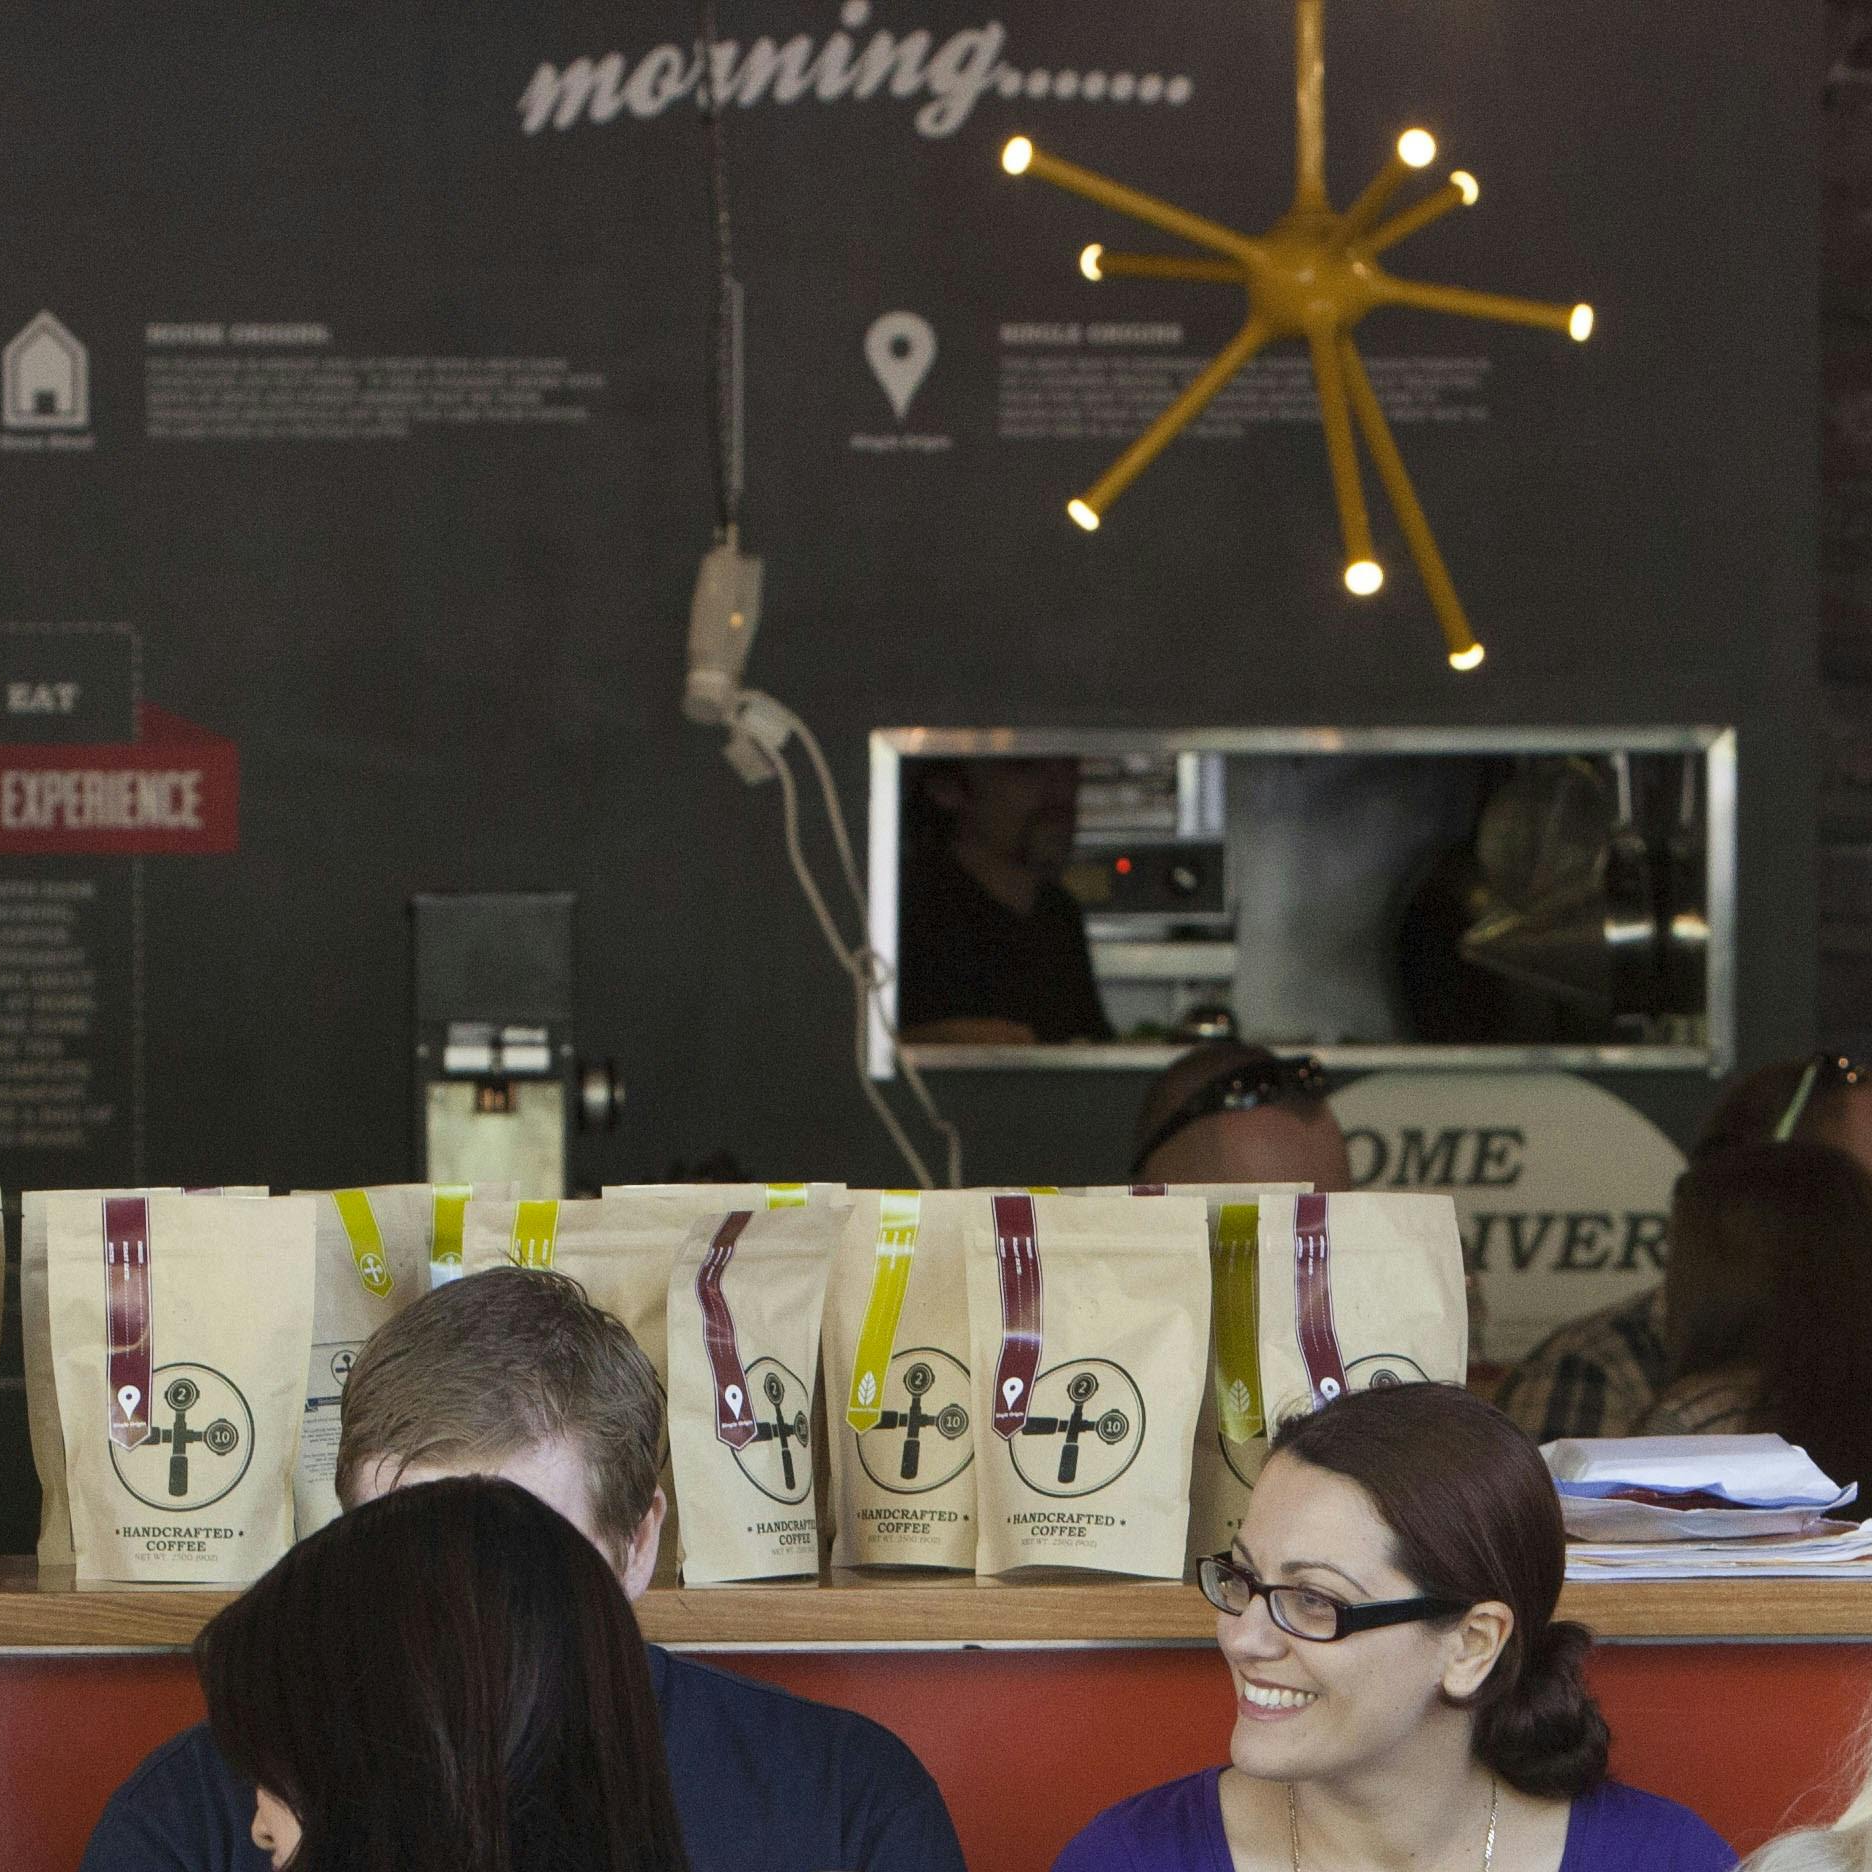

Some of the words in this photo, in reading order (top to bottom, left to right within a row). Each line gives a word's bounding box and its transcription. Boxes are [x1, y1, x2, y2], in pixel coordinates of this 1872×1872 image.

[6, 682, 81, 713] EAT
[0, 769, 203, 830] EXPERIENCE
[1345, 1126, 1526, 1187] OME
[1465, 1209, 1667, 1272] IVER
[914, 1372, 923, 1386] 2
[177, 1387, 186, 1401] 2
[1078, 1380, 1087, 1394] 2
[945, 1415, 961, 1428] 10
[1106, 1420, 1121, 1433] 10
[214, 1431, 230, 1444] 10
[861, 1508, 958, 1522] HANDCRAFTED
[1013, 1512, 1115, 1526] HANDCRAFTED
[123, 1526, 234, 1539] HANDCRAFTED
[877, 1522, 931, 1534] COFFEE
[1031, 1526, 1087, 1538] COFFEE
[146, 1540, 206, 1552] COFFEE
[779, 1533, 811, 1546] COFFEE
